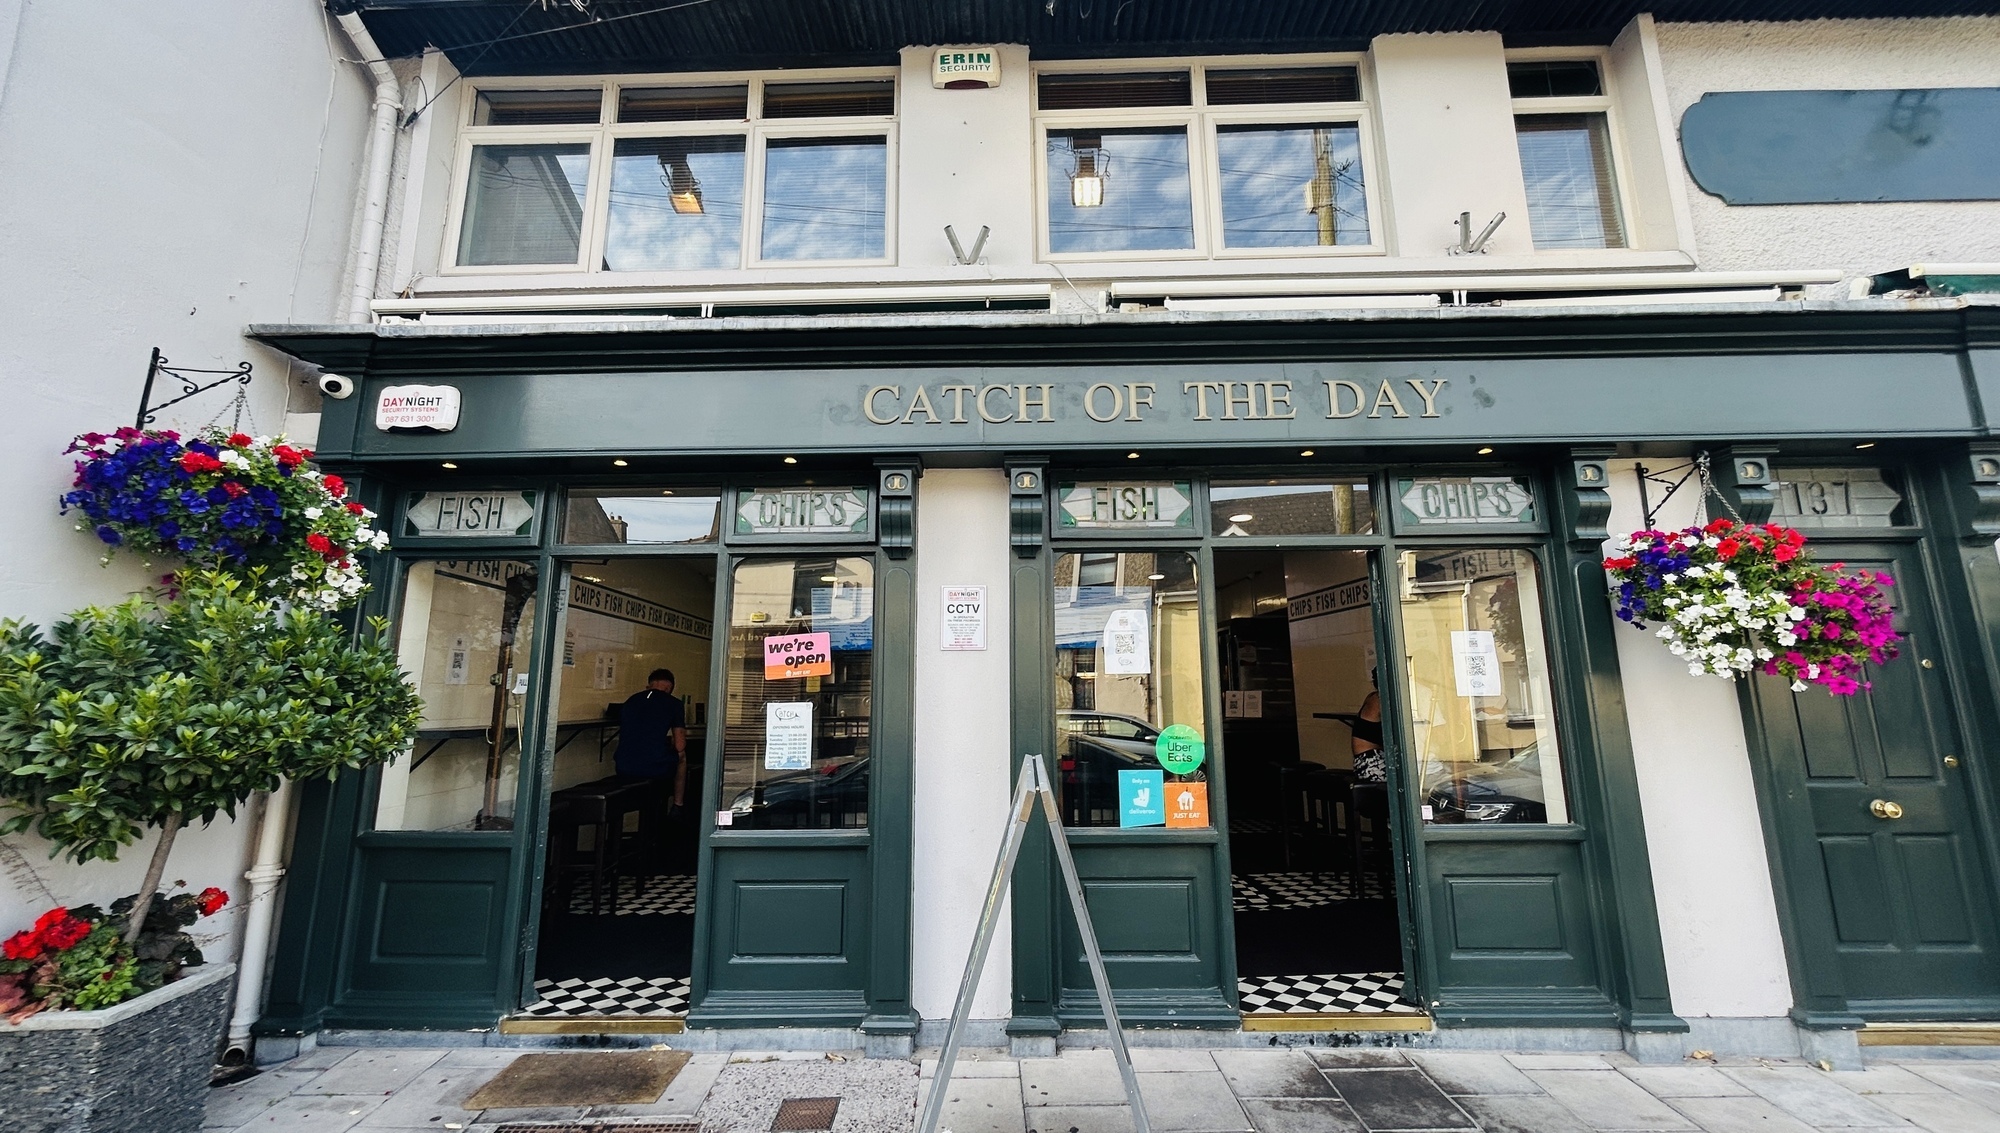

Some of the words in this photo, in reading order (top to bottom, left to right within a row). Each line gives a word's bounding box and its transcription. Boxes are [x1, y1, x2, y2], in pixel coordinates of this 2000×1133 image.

[940, 53, 991, 65] ERIN
[940, 64, 991, 73] SECURITY
[382, 397, 443, 407] DAYNIGHT
[862, 384, 1055, 425] CATCH
[1083, 382, 1156, 423] OF
[1183, 379, 1298, 421] THE
[1322, 379, 1448, 419] DAY
[760, 493, 848, 527] CHIPS
[1091, 487, 1158, 520] FISH
[1421, 483, 1511, 518] CHIPS
[1780, 481, 1851, 514] 137
[437, 497, 504, 530] FISH
[1451, 551, 1489, 580] FISH
[574, 584, 601, 608] CHIPS
[604, 593, 623, 613] FISH
[625, 600, 646, 619] CHIPS
[648, 607, 663, 624] FISH
[663, 611, 680, 628] CHIPS
[681, 617, 693, 631] FISH
[947, 603, 980, 614] CCTV
[1289, 597, 1313, 617] CHIPS
[1315, 590, 1336, 610] FISH
[1339, 583, 1369, 604] CHIPS
[785, 653, 826, 669] open
[1167, 742, 1192, 752] Uber
[1167, 752, 1193, 763] Eats
